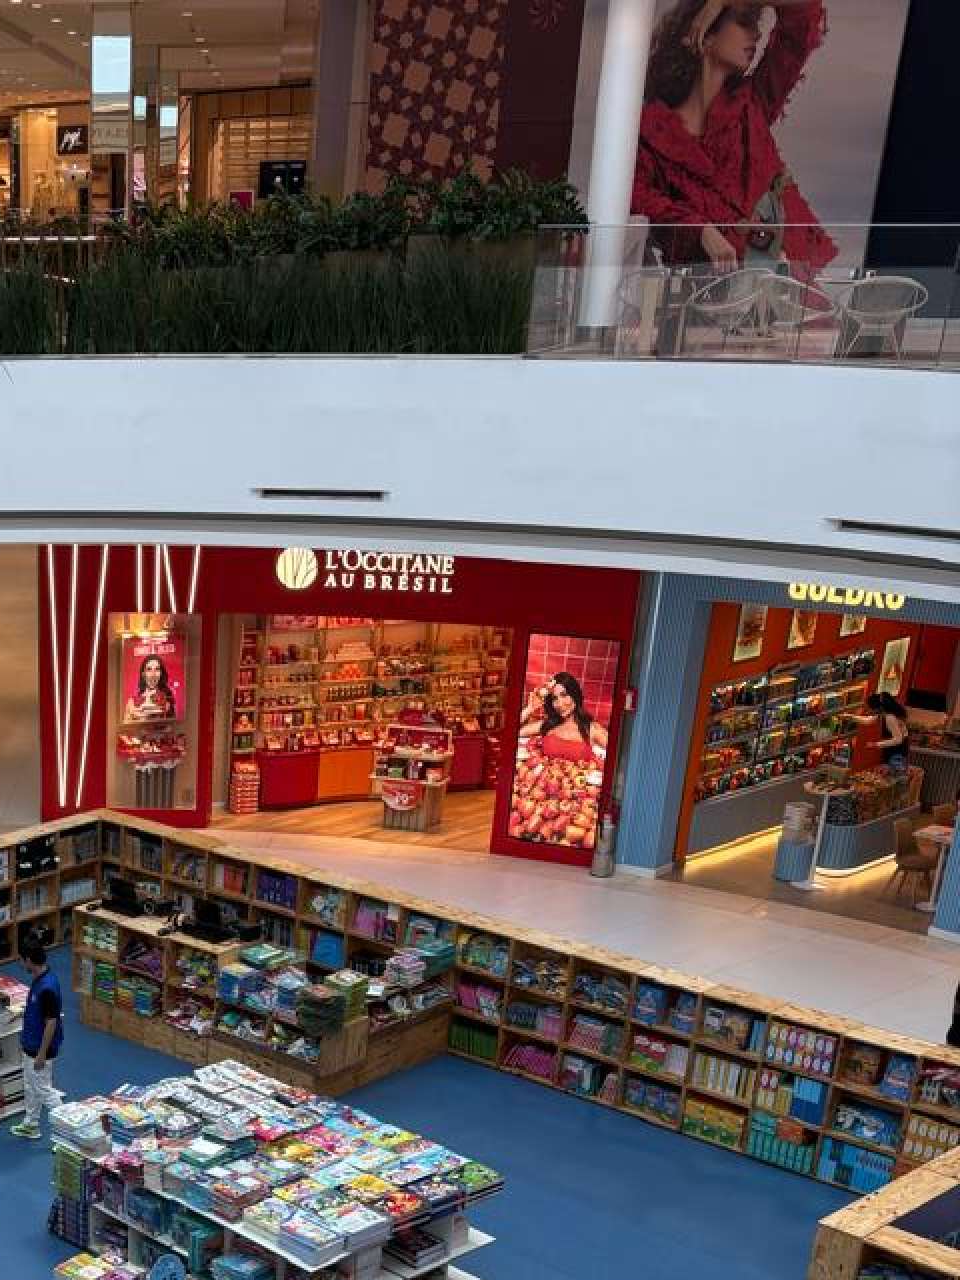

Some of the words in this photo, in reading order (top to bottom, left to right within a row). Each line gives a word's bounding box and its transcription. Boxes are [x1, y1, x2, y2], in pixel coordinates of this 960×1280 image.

[325, 549, 455, 575] L'OCCITANE
[324, 573, 355, 588] AU
[364, 571, 453, 593] BRÉSIL
